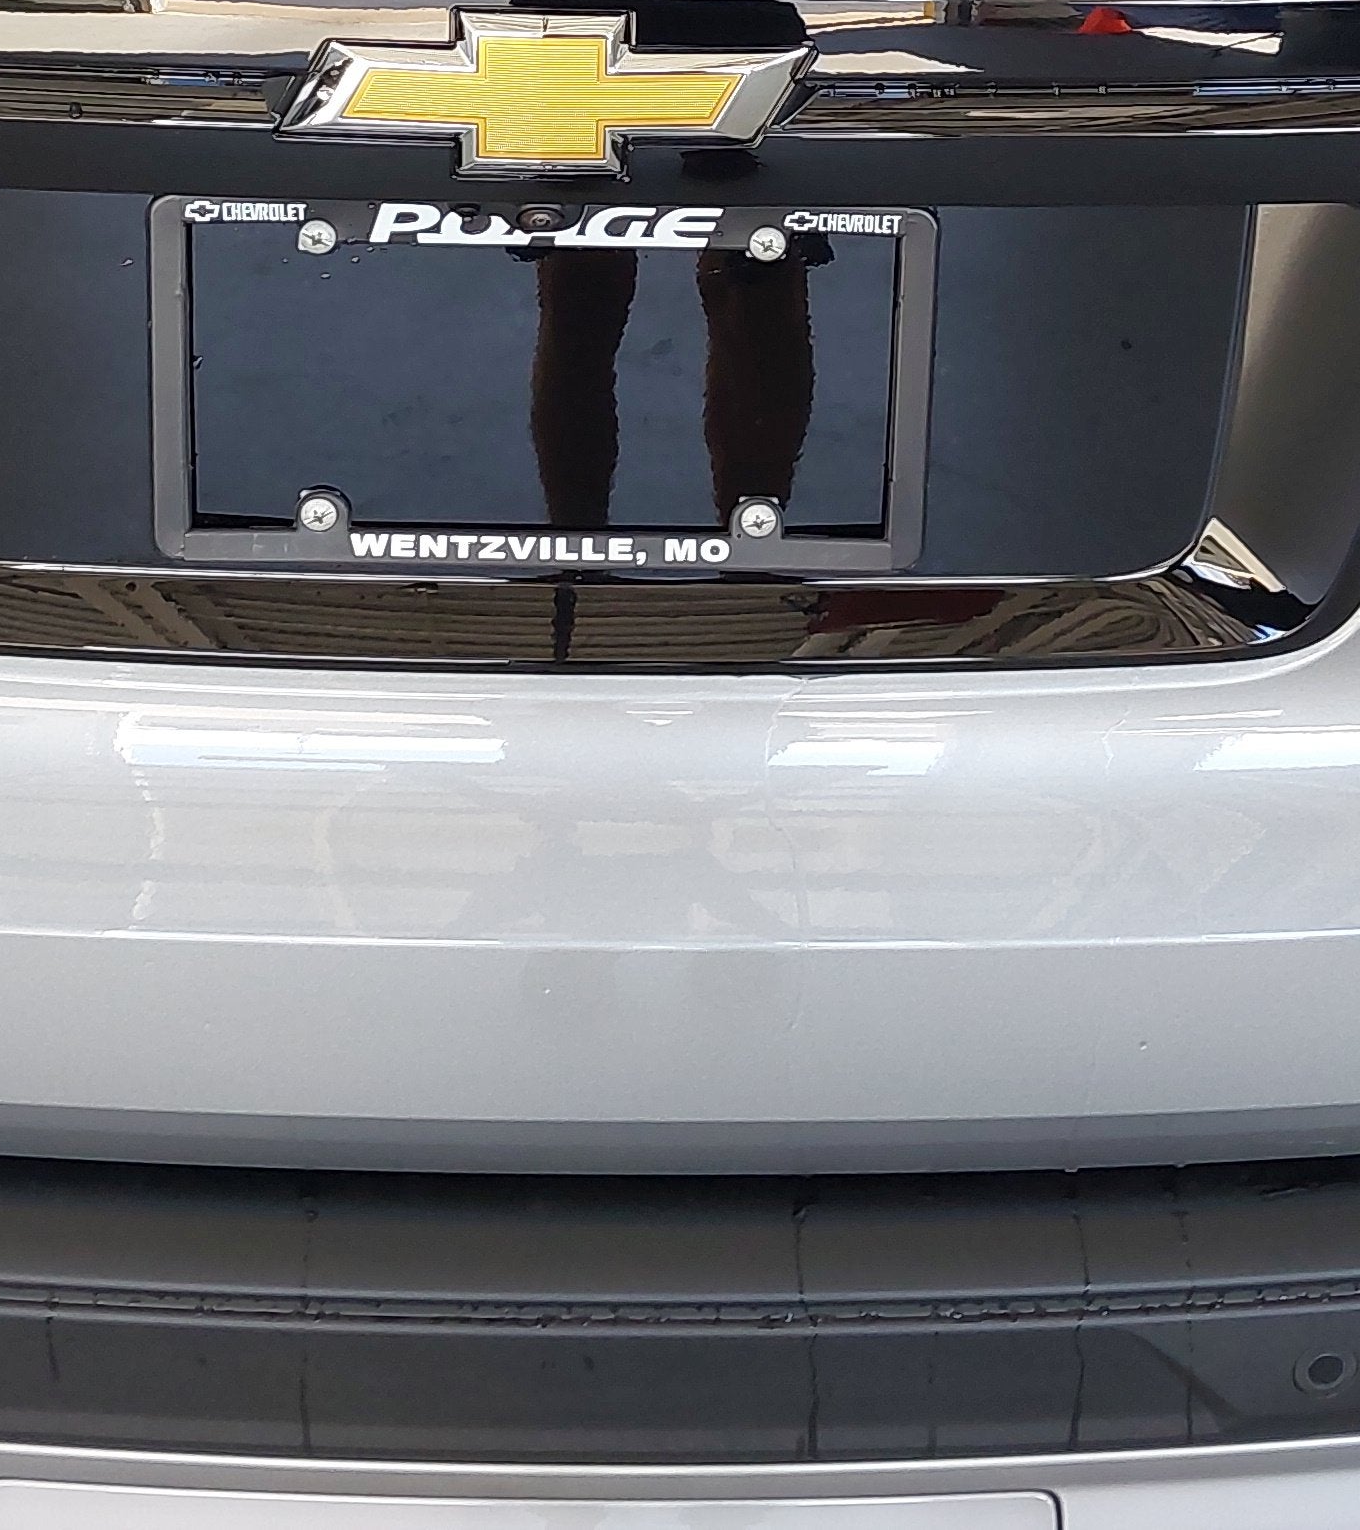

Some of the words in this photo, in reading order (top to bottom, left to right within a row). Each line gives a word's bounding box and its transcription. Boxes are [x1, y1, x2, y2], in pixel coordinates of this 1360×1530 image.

[222, 202, 307, 222] CHEVROLET
[817, 213, 903, 234] CHEVROLET
[349, 533, 647, 566] WENTZVILLE,
[663, 538, 731, 563] MO
